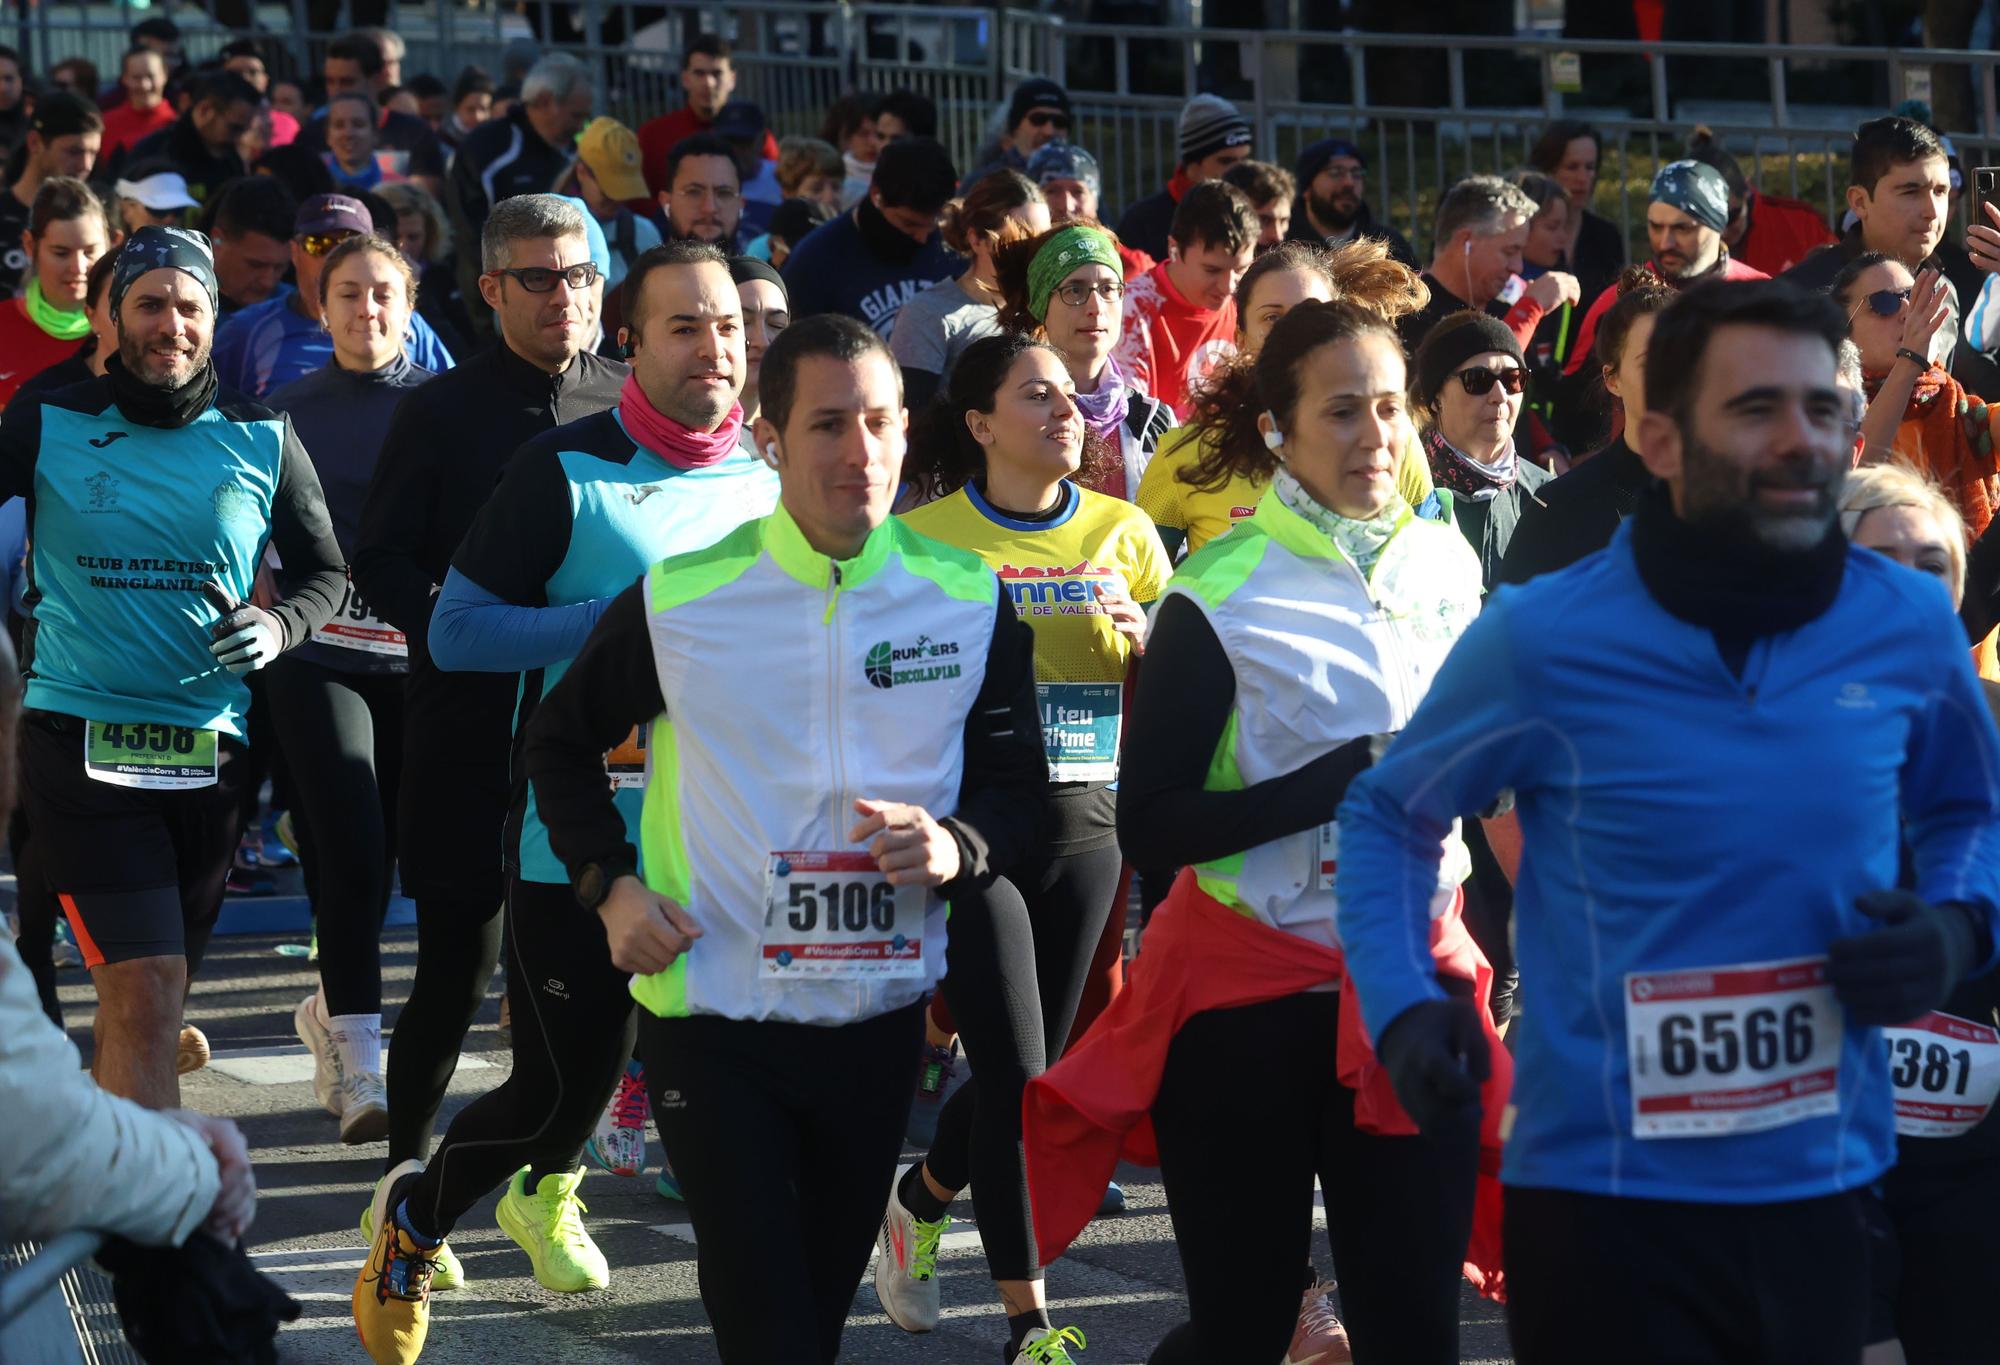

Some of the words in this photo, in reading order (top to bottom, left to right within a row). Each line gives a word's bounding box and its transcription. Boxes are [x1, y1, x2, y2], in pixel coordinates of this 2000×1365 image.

[77, 555, 123, 571] CLUB
[127, 558, 229, 574] ATLETISMO
[90, 575, 213, 592] MINGLANILL
[1033, 606, 1053, 615] DE
[893, 664, 962, 685] ESCOLAPIAS
[1057, 705, 1093, 725] teu
[102, 724, 195, 754] 4358
[1043, 727, 1096, 747] Ritme
[117, 765, 177, 776] #ValènciaCorre
[787, 882, 896, 932] 5106
[1658, 1002, 1814, 1079] 6566
